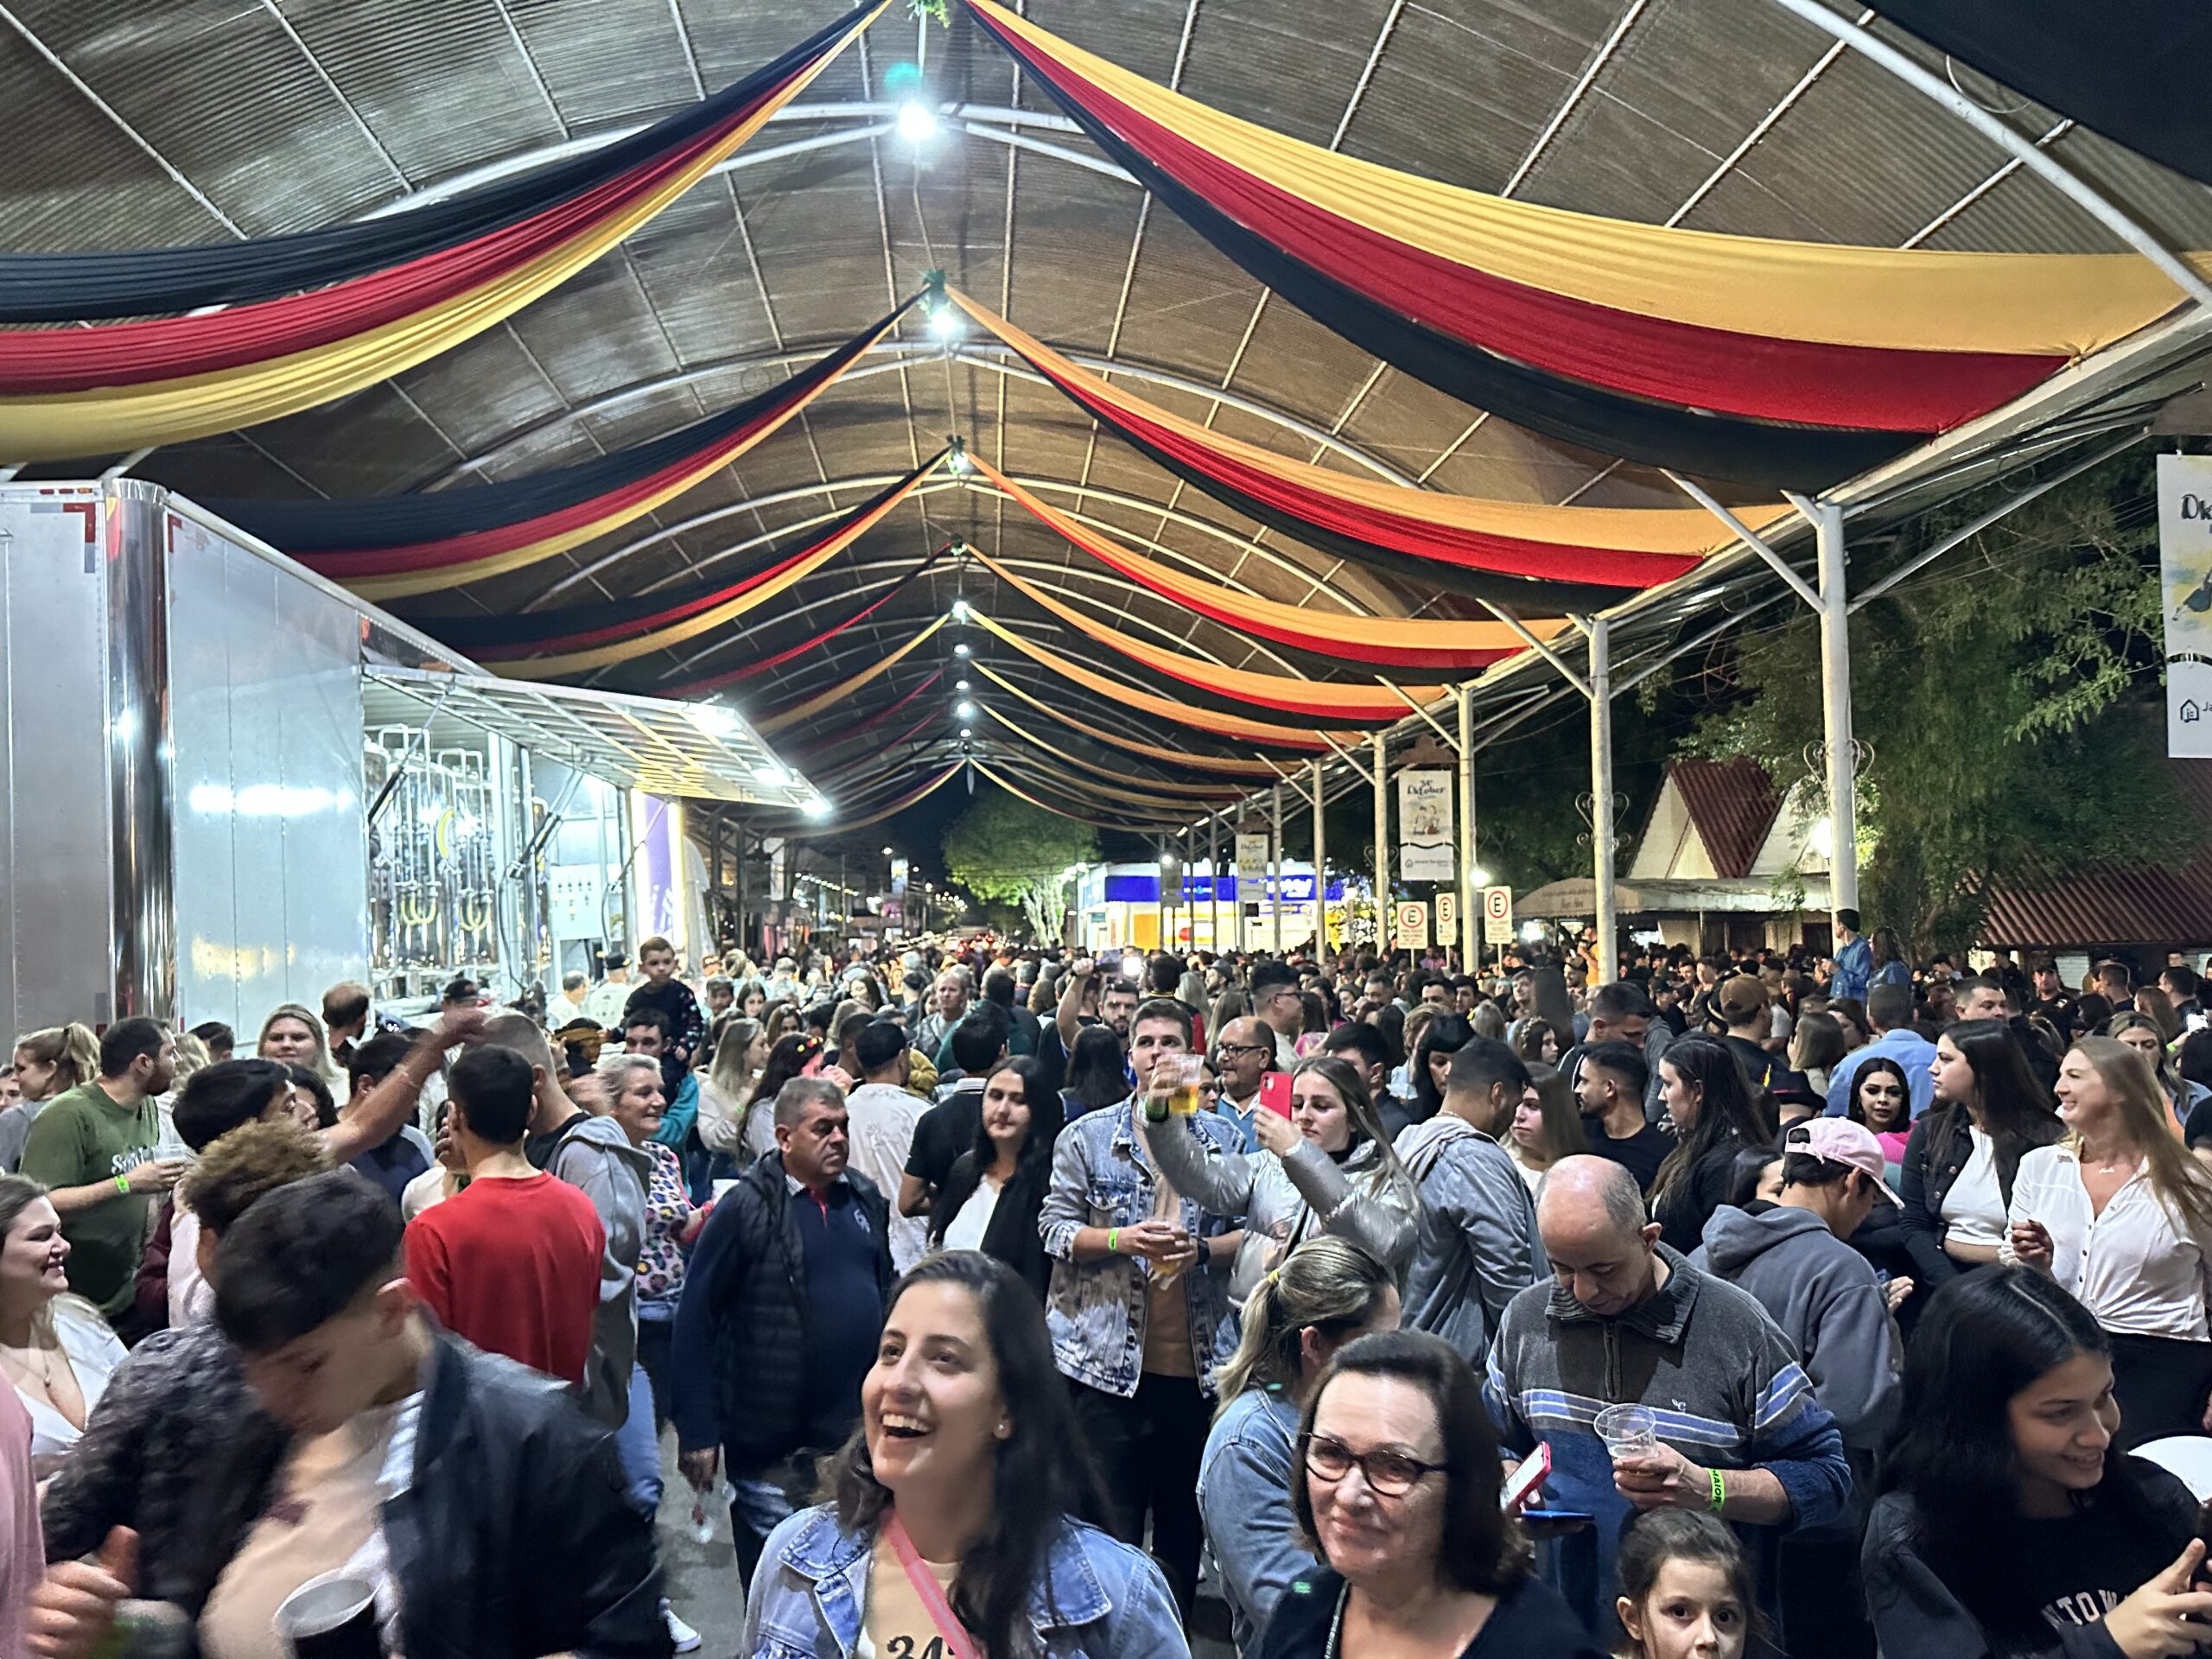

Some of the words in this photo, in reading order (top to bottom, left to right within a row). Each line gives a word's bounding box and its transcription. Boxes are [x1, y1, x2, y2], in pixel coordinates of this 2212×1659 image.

[1443, 902, 1448, 917] E
[1494, 897, 1501, 912] E
[1408, 910, 1416, 923] E
